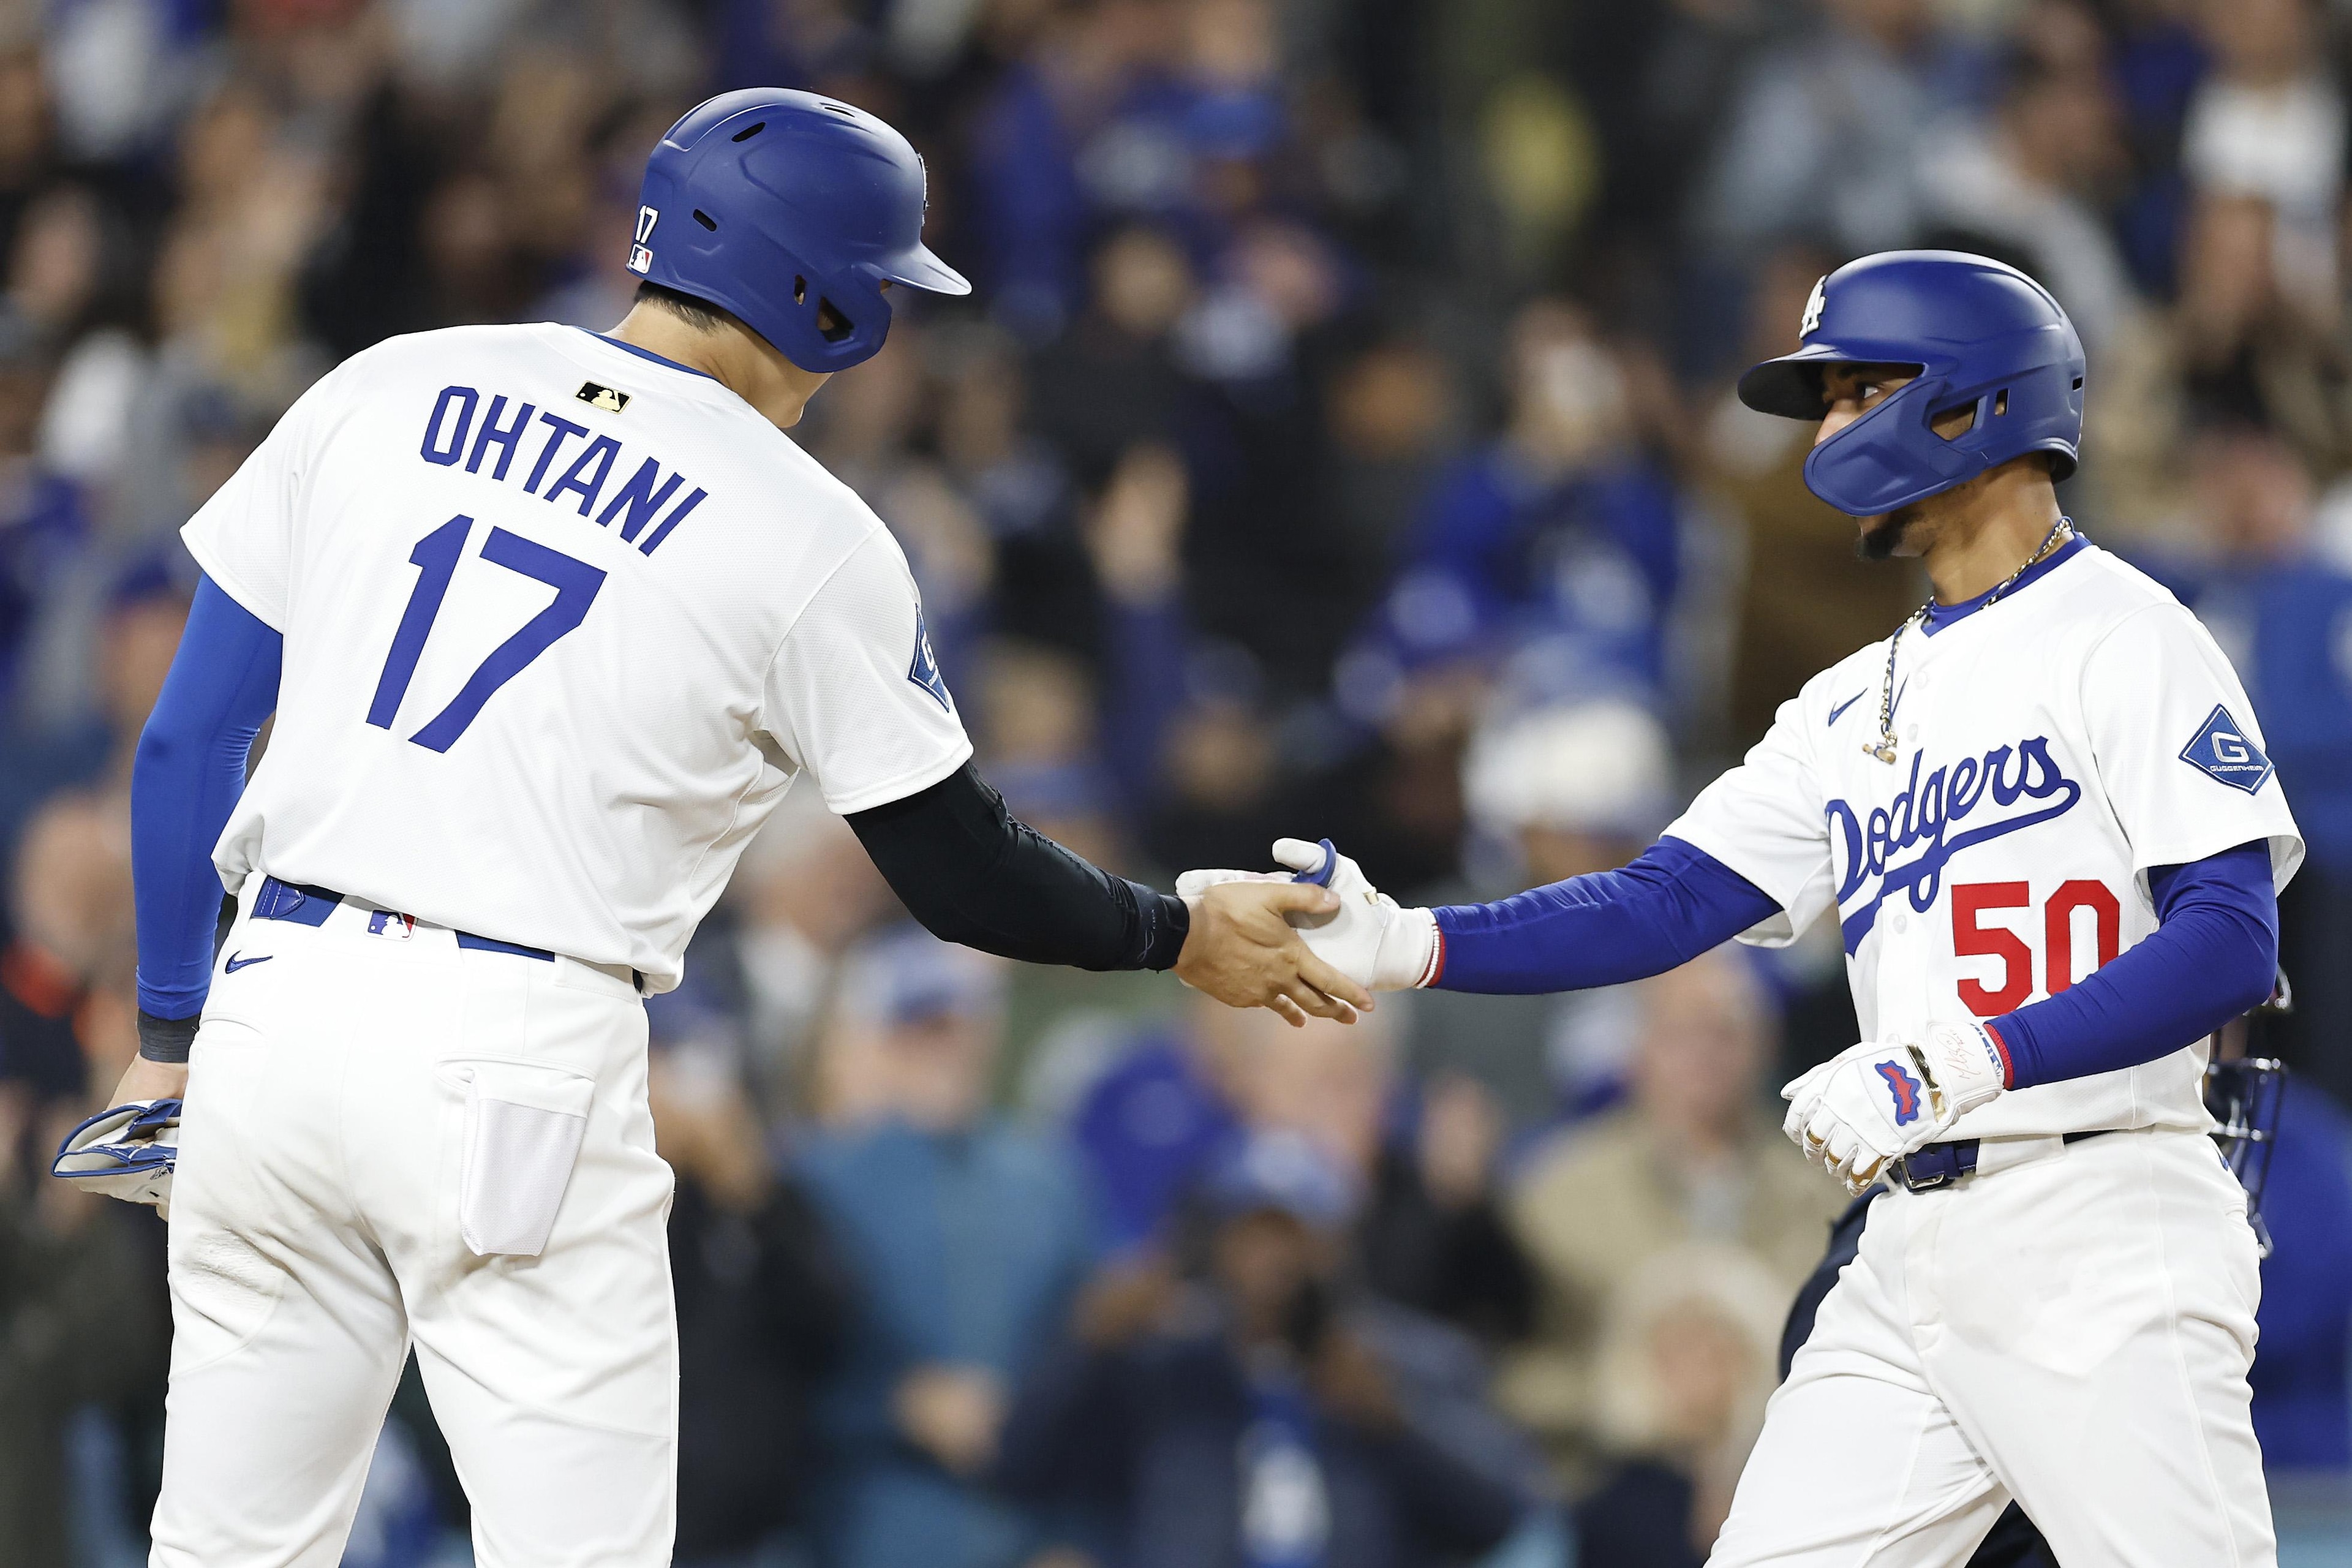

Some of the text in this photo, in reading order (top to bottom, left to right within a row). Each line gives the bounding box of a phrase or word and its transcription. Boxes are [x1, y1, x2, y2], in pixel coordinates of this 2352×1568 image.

[635, 205, 659, 244] 17
[420, 386, 708, 557] OHTANI
[366, 514, 608, 753] 17
[2212, 732, 2249, 763] G
[1825, 736, 2081, 960] Dodgers
[1951, 880, 2120, 1017] 50
